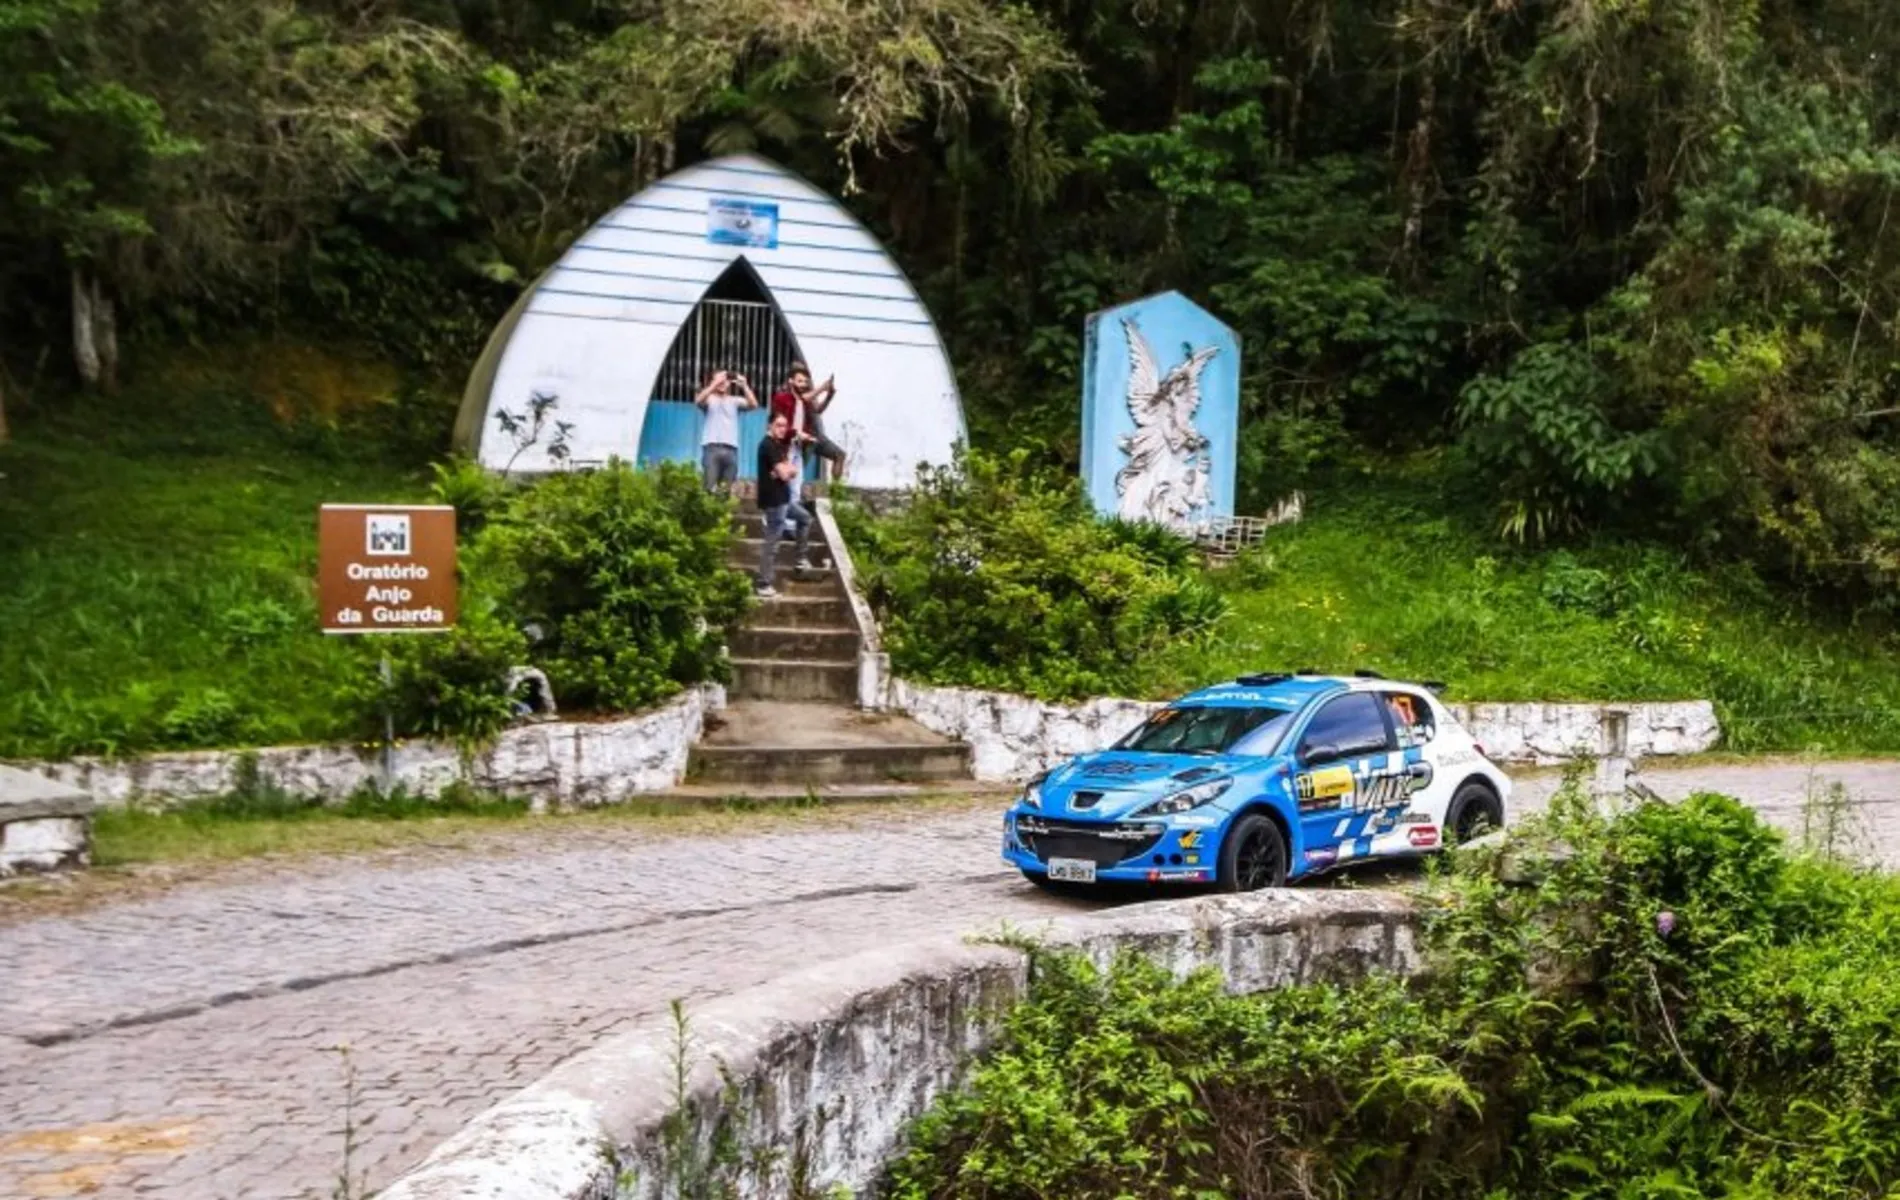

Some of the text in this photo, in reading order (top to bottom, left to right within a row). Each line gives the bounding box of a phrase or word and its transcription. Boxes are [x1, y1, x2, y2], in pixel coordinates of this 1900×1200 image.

[347, 562, 429, 580] Oratório
[366, 585, 412, 604] Anjo
[337, 605, 444, 623] da Guarda
[1391, 695, 1416, 725] 17
